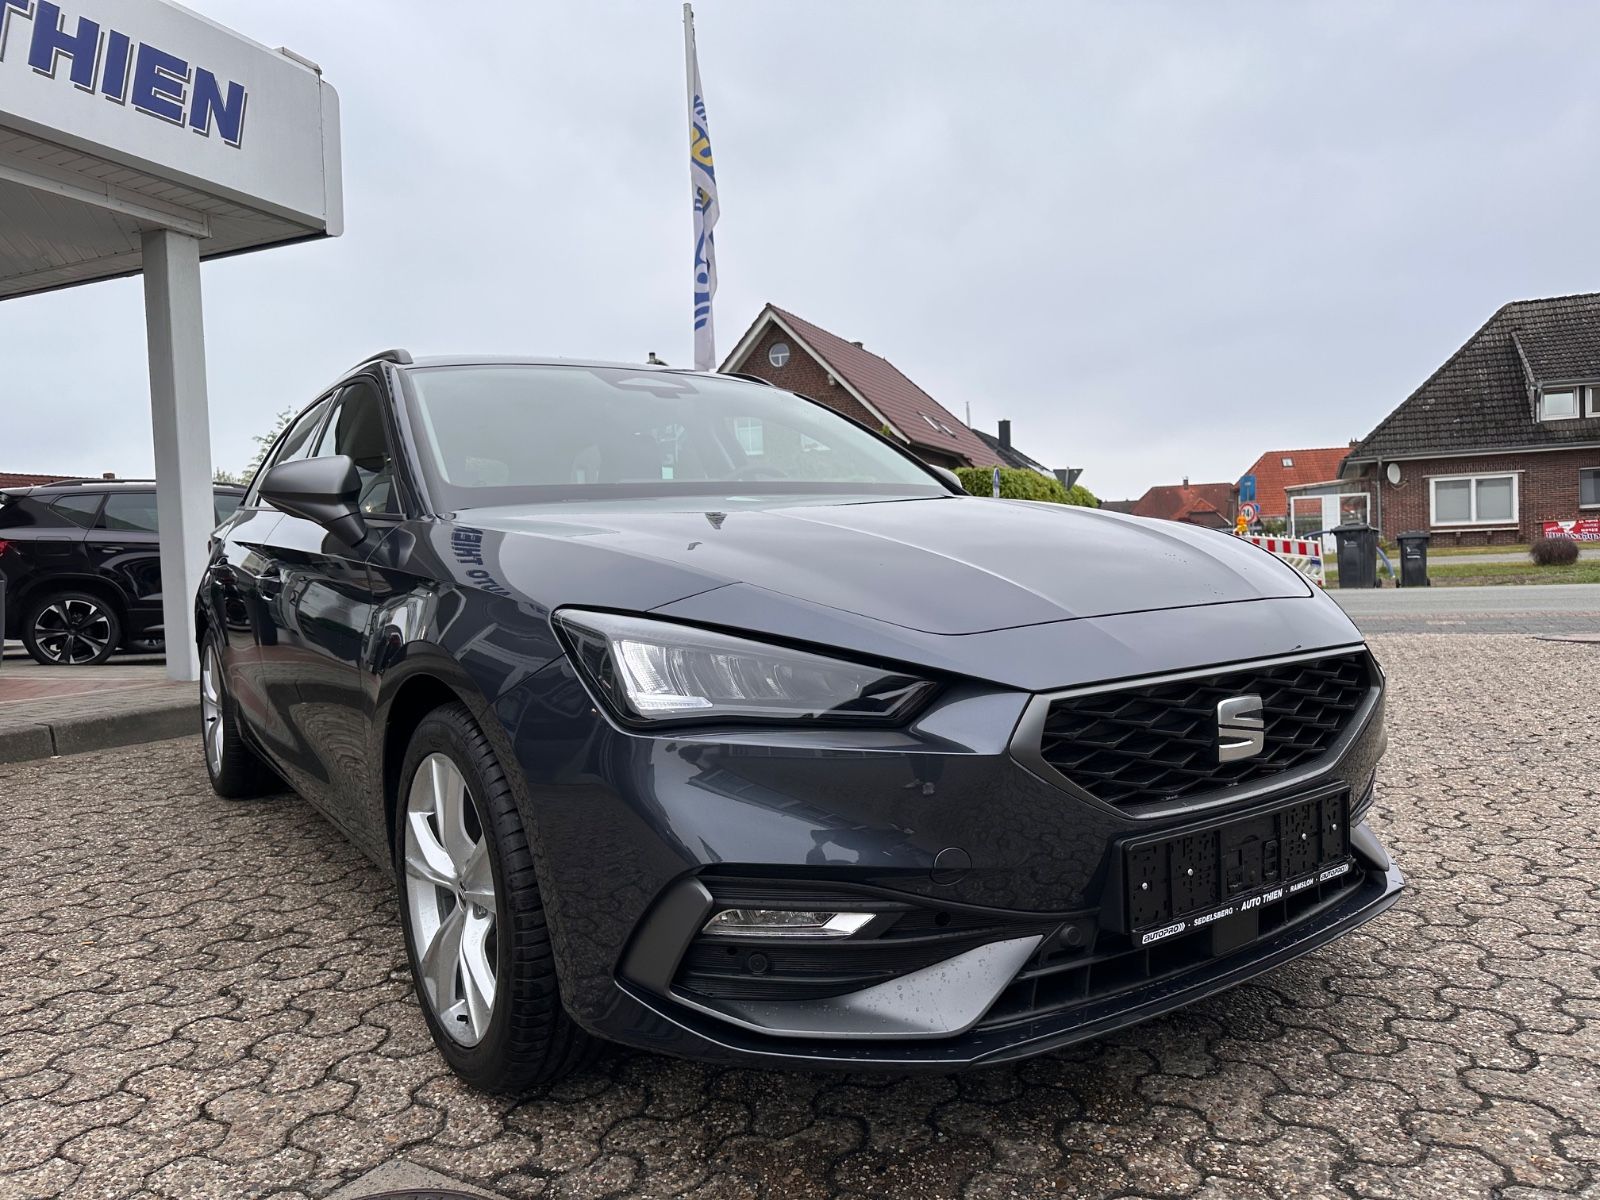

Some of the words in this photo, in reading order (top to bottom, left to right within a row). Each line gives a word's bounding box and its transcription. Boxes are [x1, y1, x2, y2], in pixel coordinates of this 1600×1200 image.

[1193, 907, 1233, 926] SEDELSBERG
[1240, 897, 1261, 912] AUTO
[1262, 888, 1283, 903] THIEN
